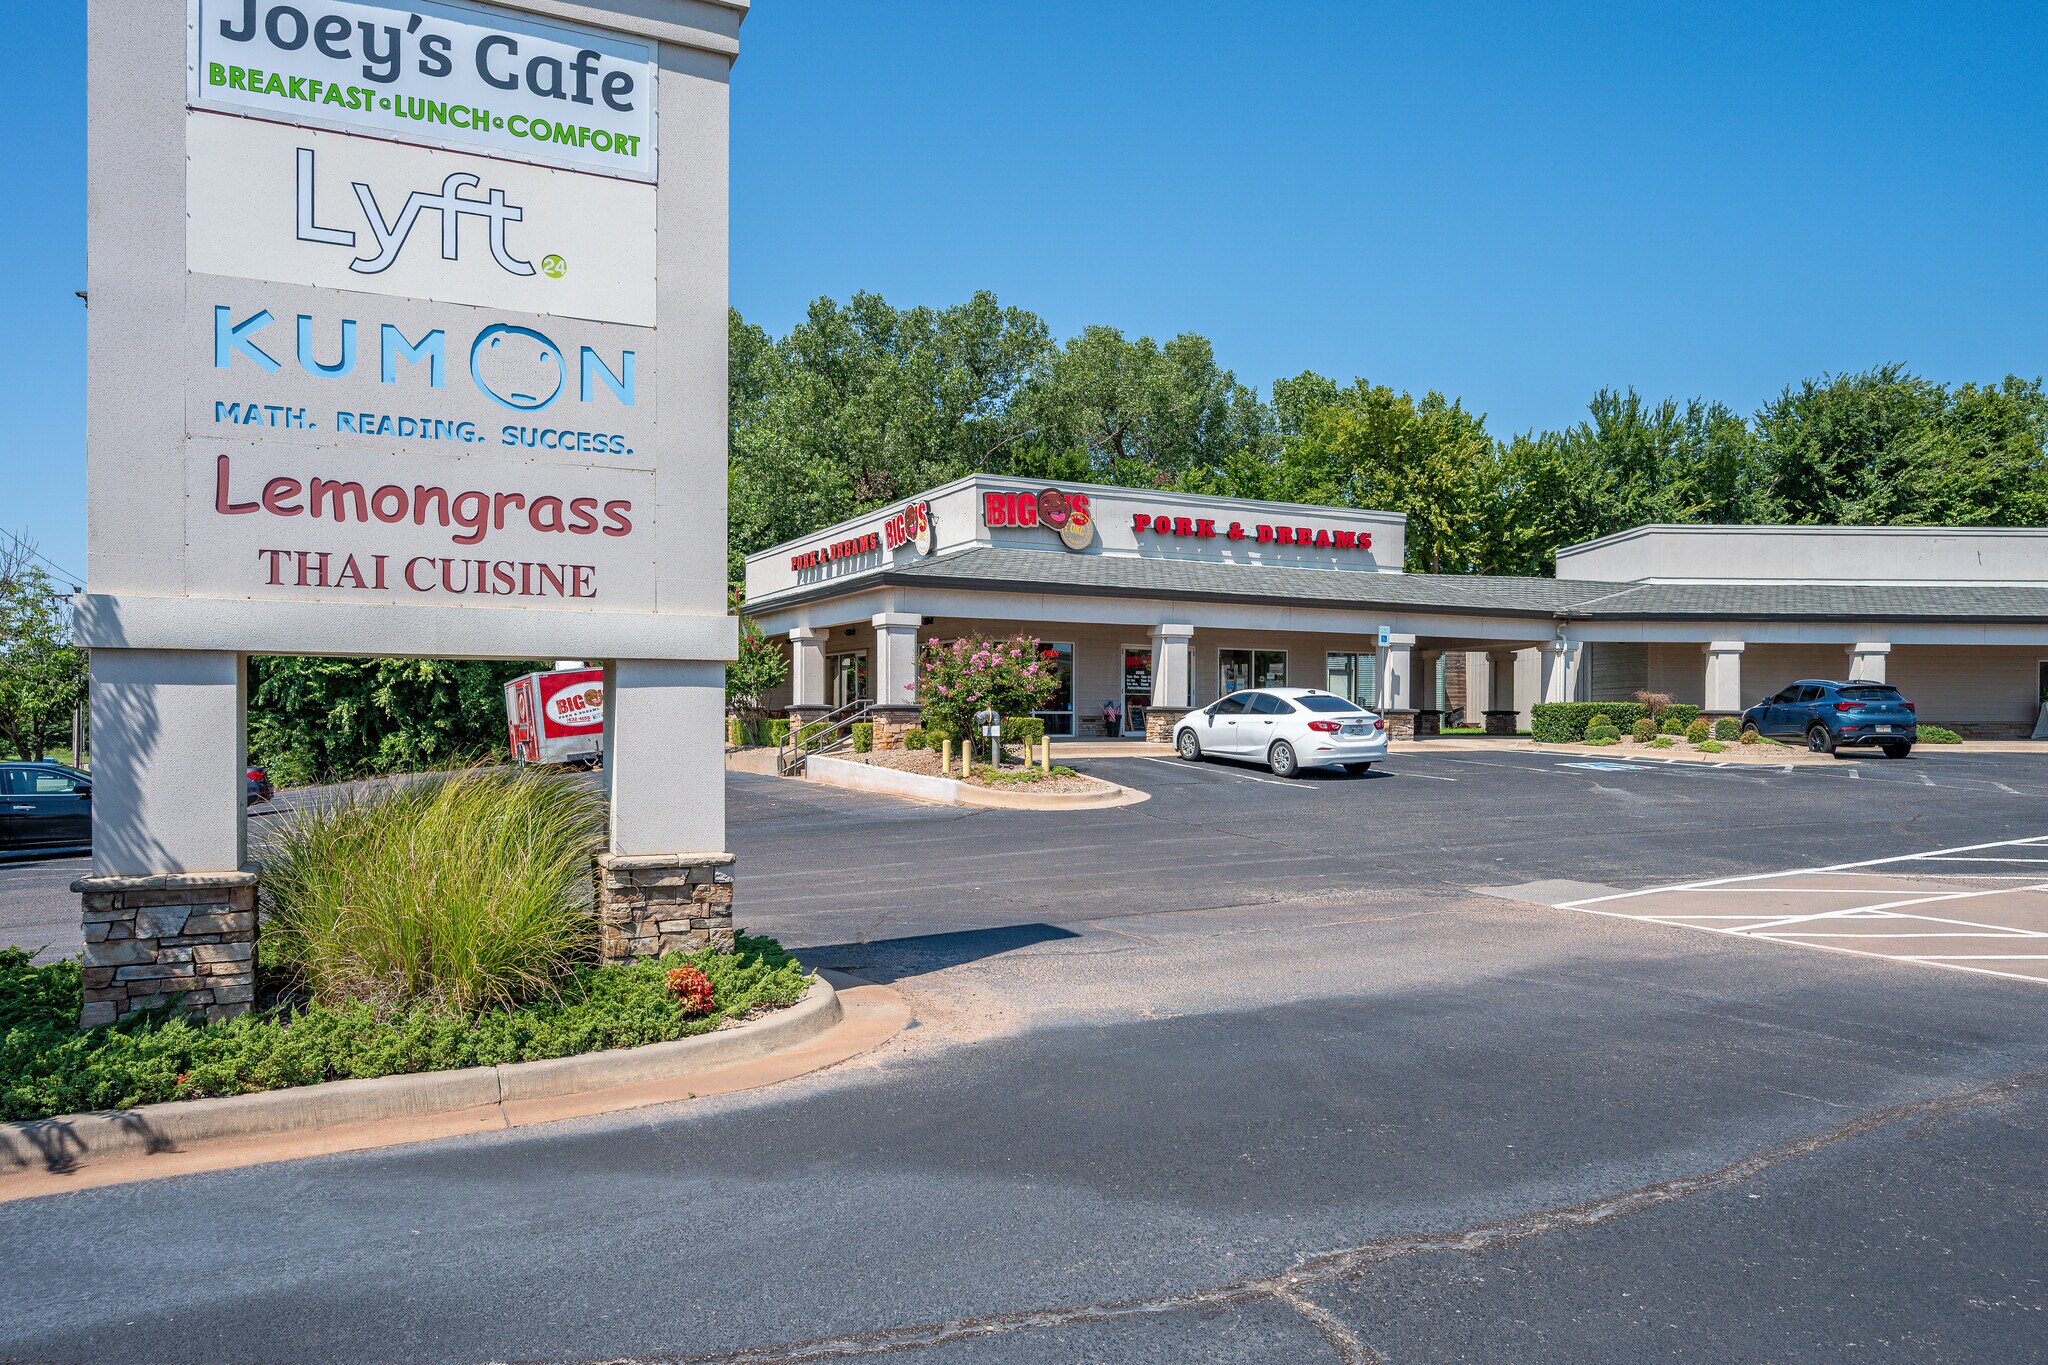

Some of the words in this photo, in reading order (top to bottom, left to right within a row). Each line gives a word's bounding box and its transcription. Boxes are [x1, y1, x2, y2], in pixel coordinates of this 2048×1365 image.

[219, 0, 452, 83] Joey's
[475, 34, 634, 112] Cafe
[209, 61, 375, 111] BREAKFAST
[395, 97, 489, 131] LUNCH
[507, 114, 641, 157] COMFORT
[296, 147, 537, 276] Lyft
[543, 258, 566, 275] 24
[214, 304, 636, 413] KUMON
[215, 401, 317, 430] MATH.
[337, 411, 486, 444] READING.
[502, 424, 634, 456] SUCCESS.
[216, 454, 633, 545] Lemongrass
[985, 492, 1037, 528] BIG
[791, 555, 817, 572] PORK
[820, 548, 829, 562] &
[829, 533, 878, 562] DREAMS
[884, 513, 906, 551] BIG
[1133, 514, 1216, 538] PORK
[1228, 522, 1245, 540] &
[1256, 524, 1372, 549] DREAMS
[258, 549, 389, 590] THAI
[404, 556, 598, 598] CUISINE
[556, 694, 586, 715] BIG
